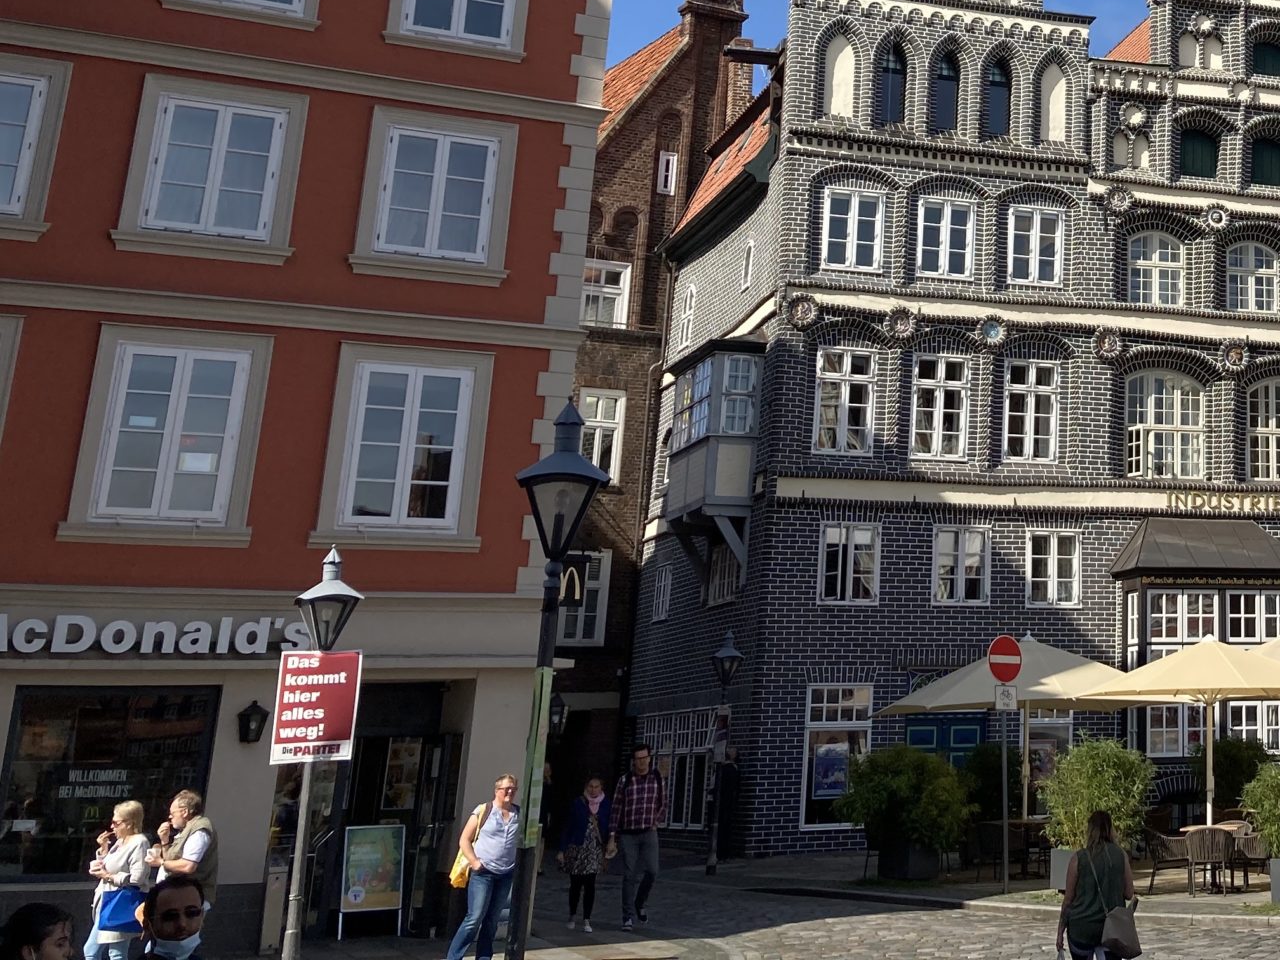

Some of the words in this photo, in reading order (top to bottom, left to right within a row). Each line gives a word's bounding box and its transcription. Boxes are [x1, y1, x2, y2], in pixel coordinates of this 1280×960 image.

[0, 614, 312, 655] cDonald's
[287, 656, 320, 669] Das
[285, 672, 347, 686] kommt
[283, 690, 320, 703] hier
[281, 707, 325, 721] alles
[279, 723, 325, 740] weg!
[282, 746, 293, 755] Die
[293, 743, 341, 756] PARTEI
[68, 769, 128, 782] WILLKOMMEN
[58, 786, 72, 798] BEI
